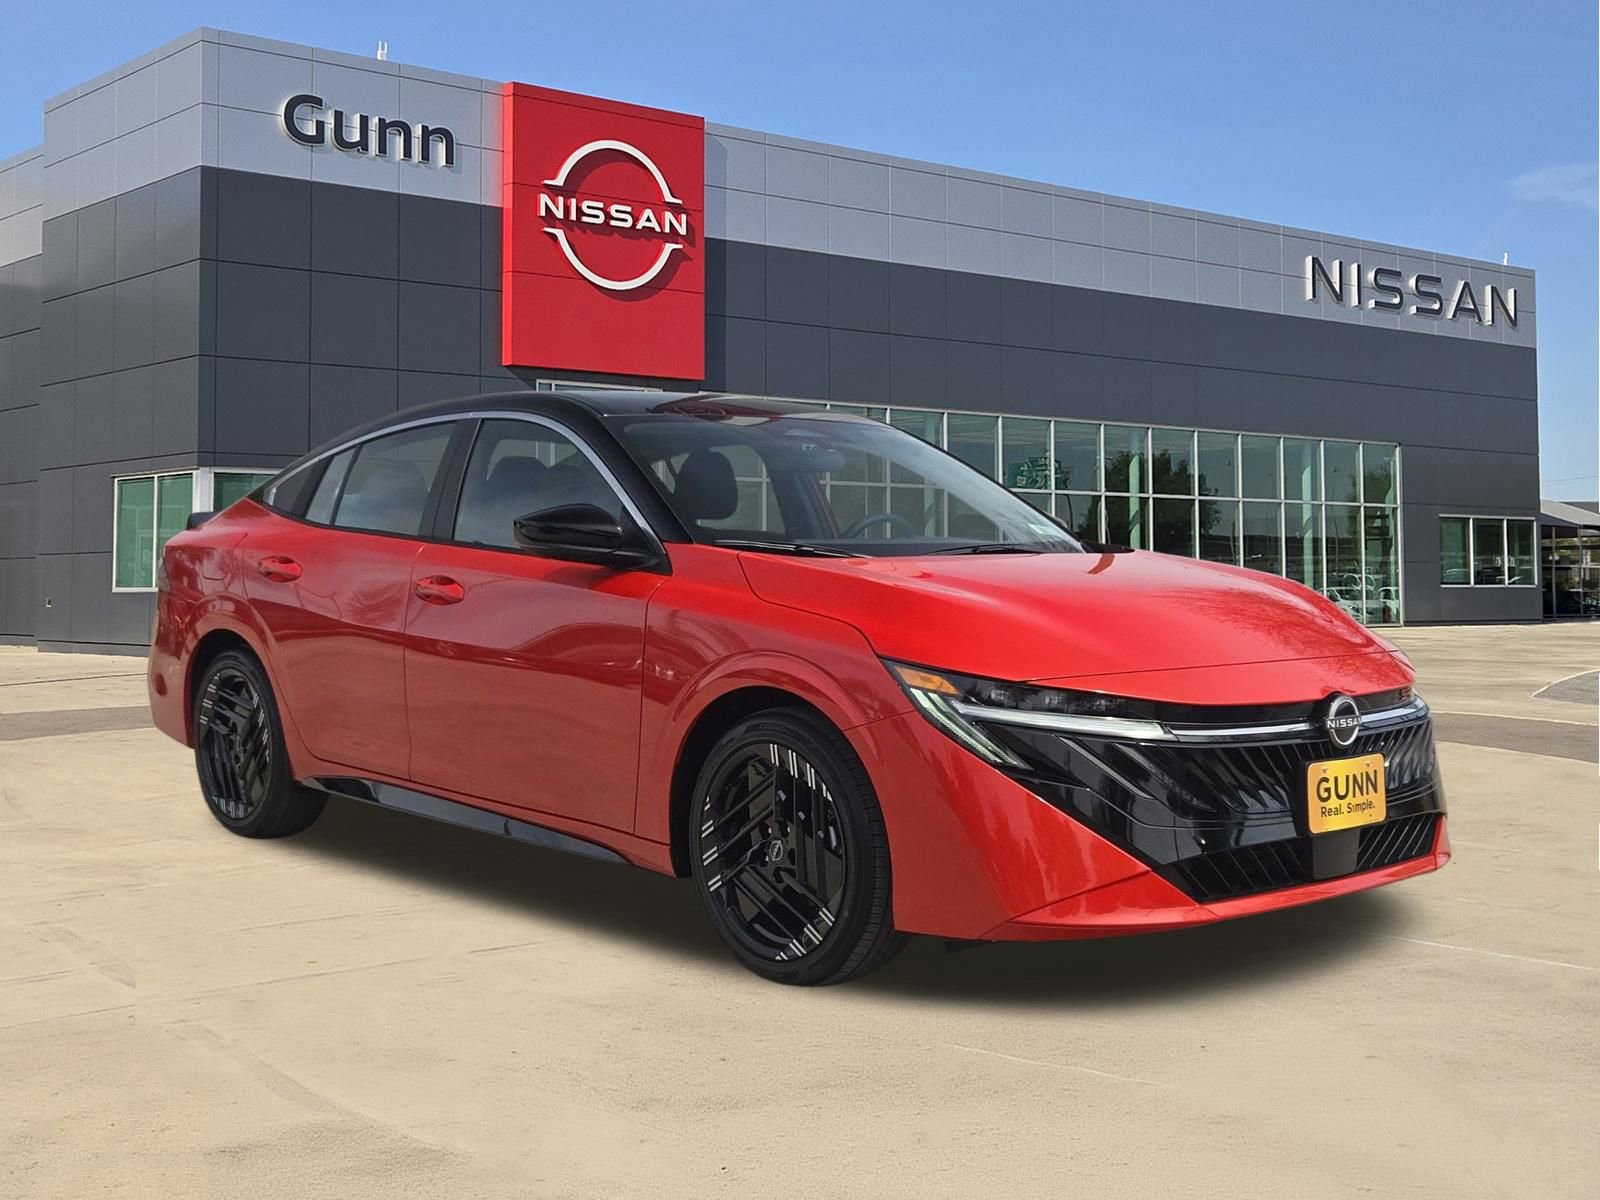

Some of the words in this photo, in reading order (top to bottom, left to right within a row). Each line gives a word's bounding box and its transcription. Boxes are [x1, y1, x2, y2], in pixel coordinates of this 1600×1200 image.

[281, 93, 456, 168] Gunn
[537, 193, 688, 236] NISSAN
[1305, 255, 1518, 327] NISSAN
[1316, 769, 1378, 803] GUNN
[1320, 803, 1344, 818] Real.
[1346, 799, 1376, 814] Simple.
